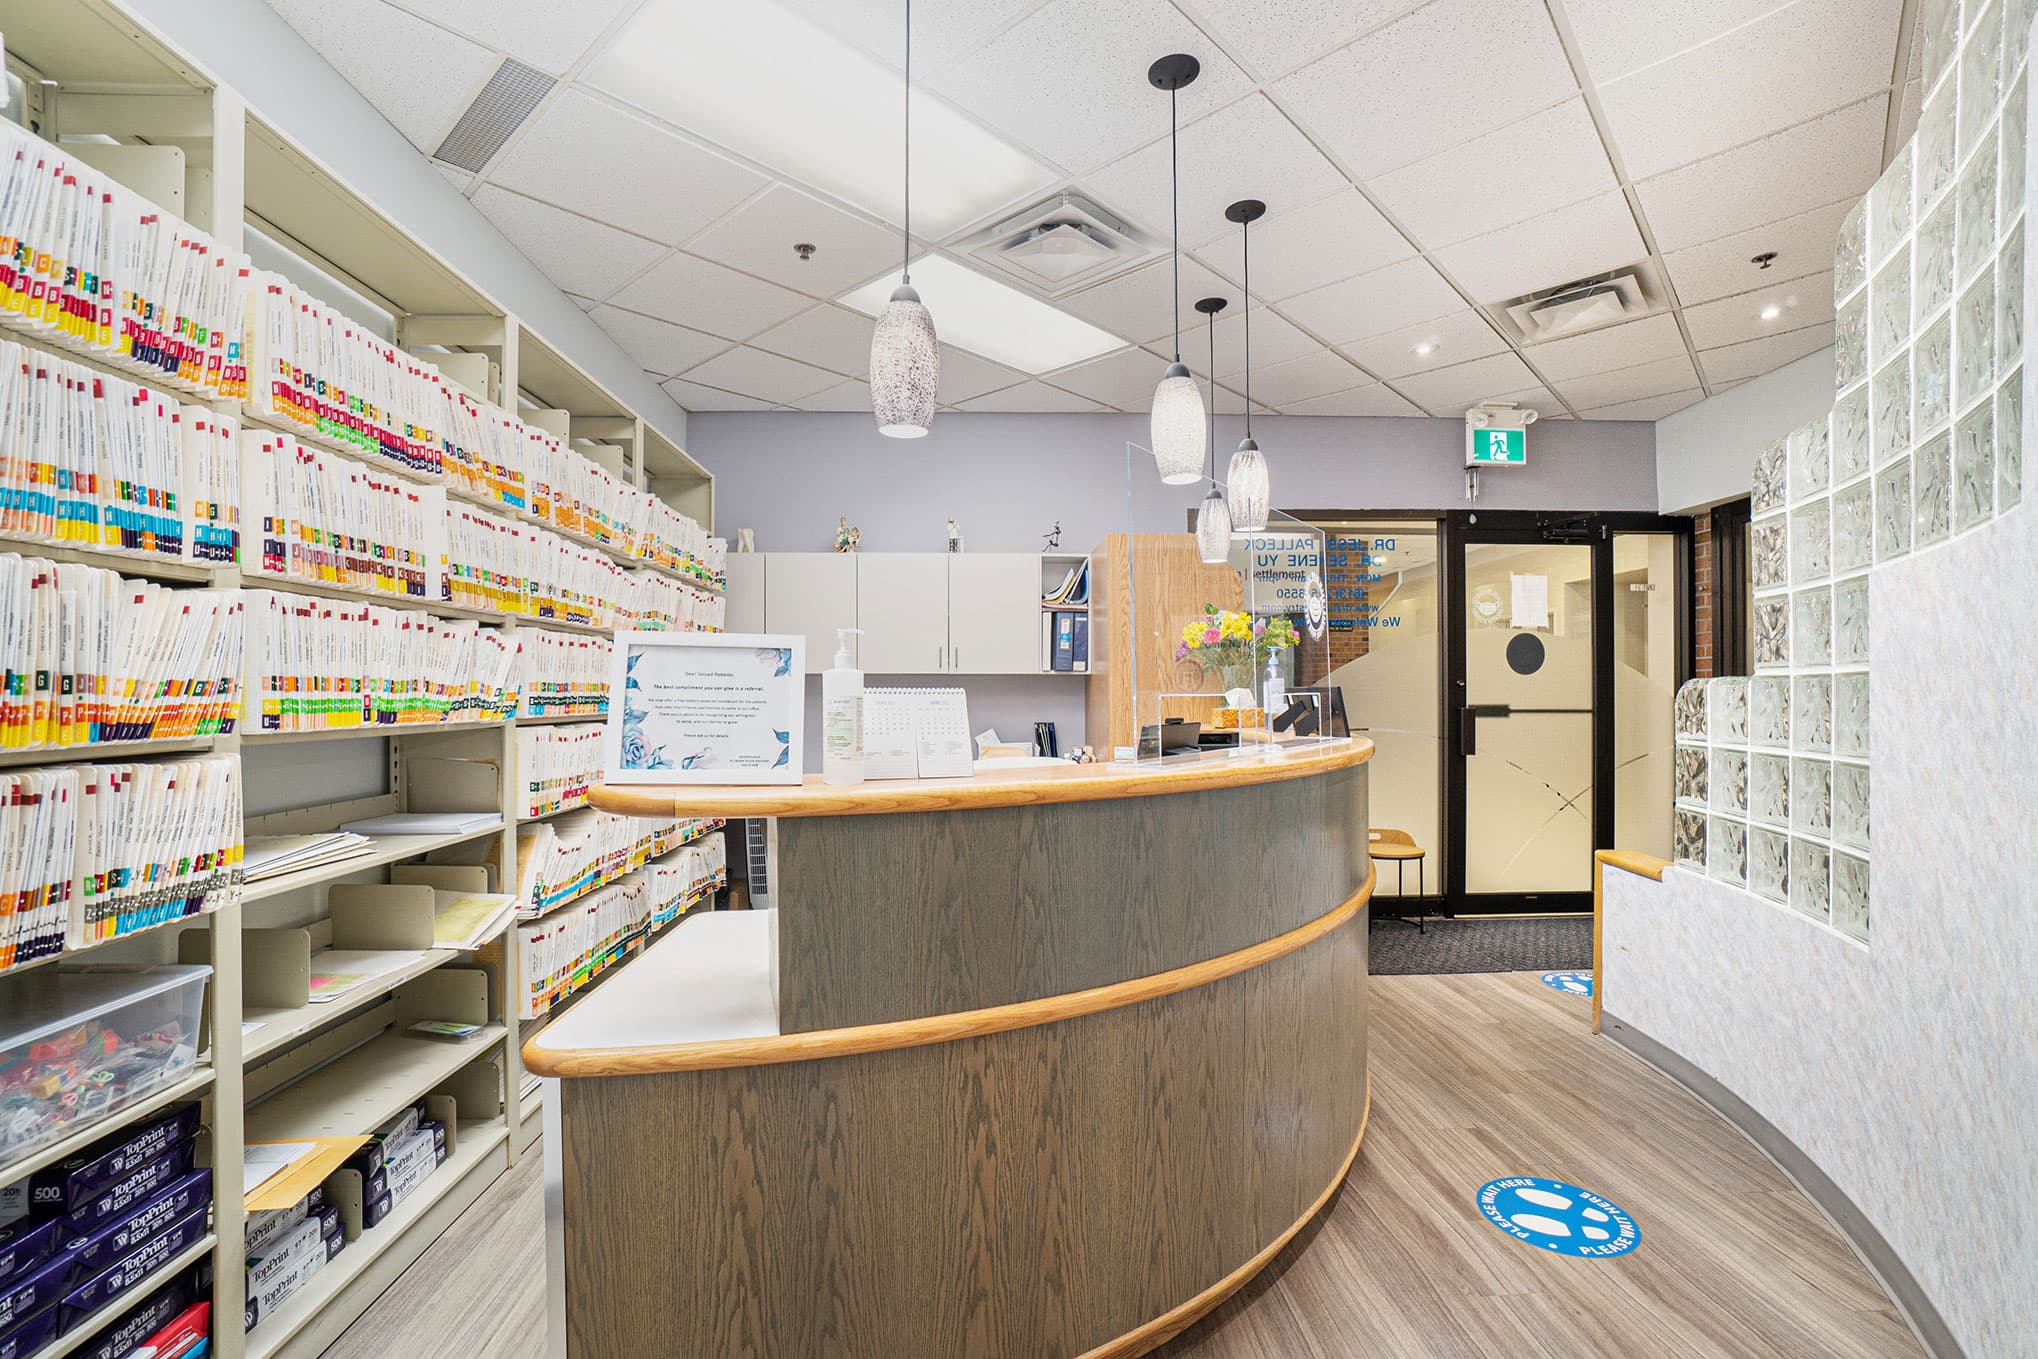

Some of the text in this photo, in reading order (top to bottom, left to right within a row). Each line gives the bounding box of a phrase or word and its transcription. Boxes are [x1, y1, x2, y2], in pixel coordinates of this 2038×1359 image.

[123, 1126, 166, 1157] TopPrint
[34, 1186, 61, 1200] 500
[111, 1165, 157, 1197] TopPrint
[127, 1197, 174, 1231] TopPrint
[1481, 1178, 1536, 1239] PLEASE WAIT HERE
[1578, 1191, 1636, 1256] PLEASE WAIT HERE
[245, 1220, 276, 1250] opPrint
[121, 1236, 169, 1272] TopPrint
[252, 1248, 290, 1283] TopPrint
[262, 1271, 299, 1306] TopPrint
